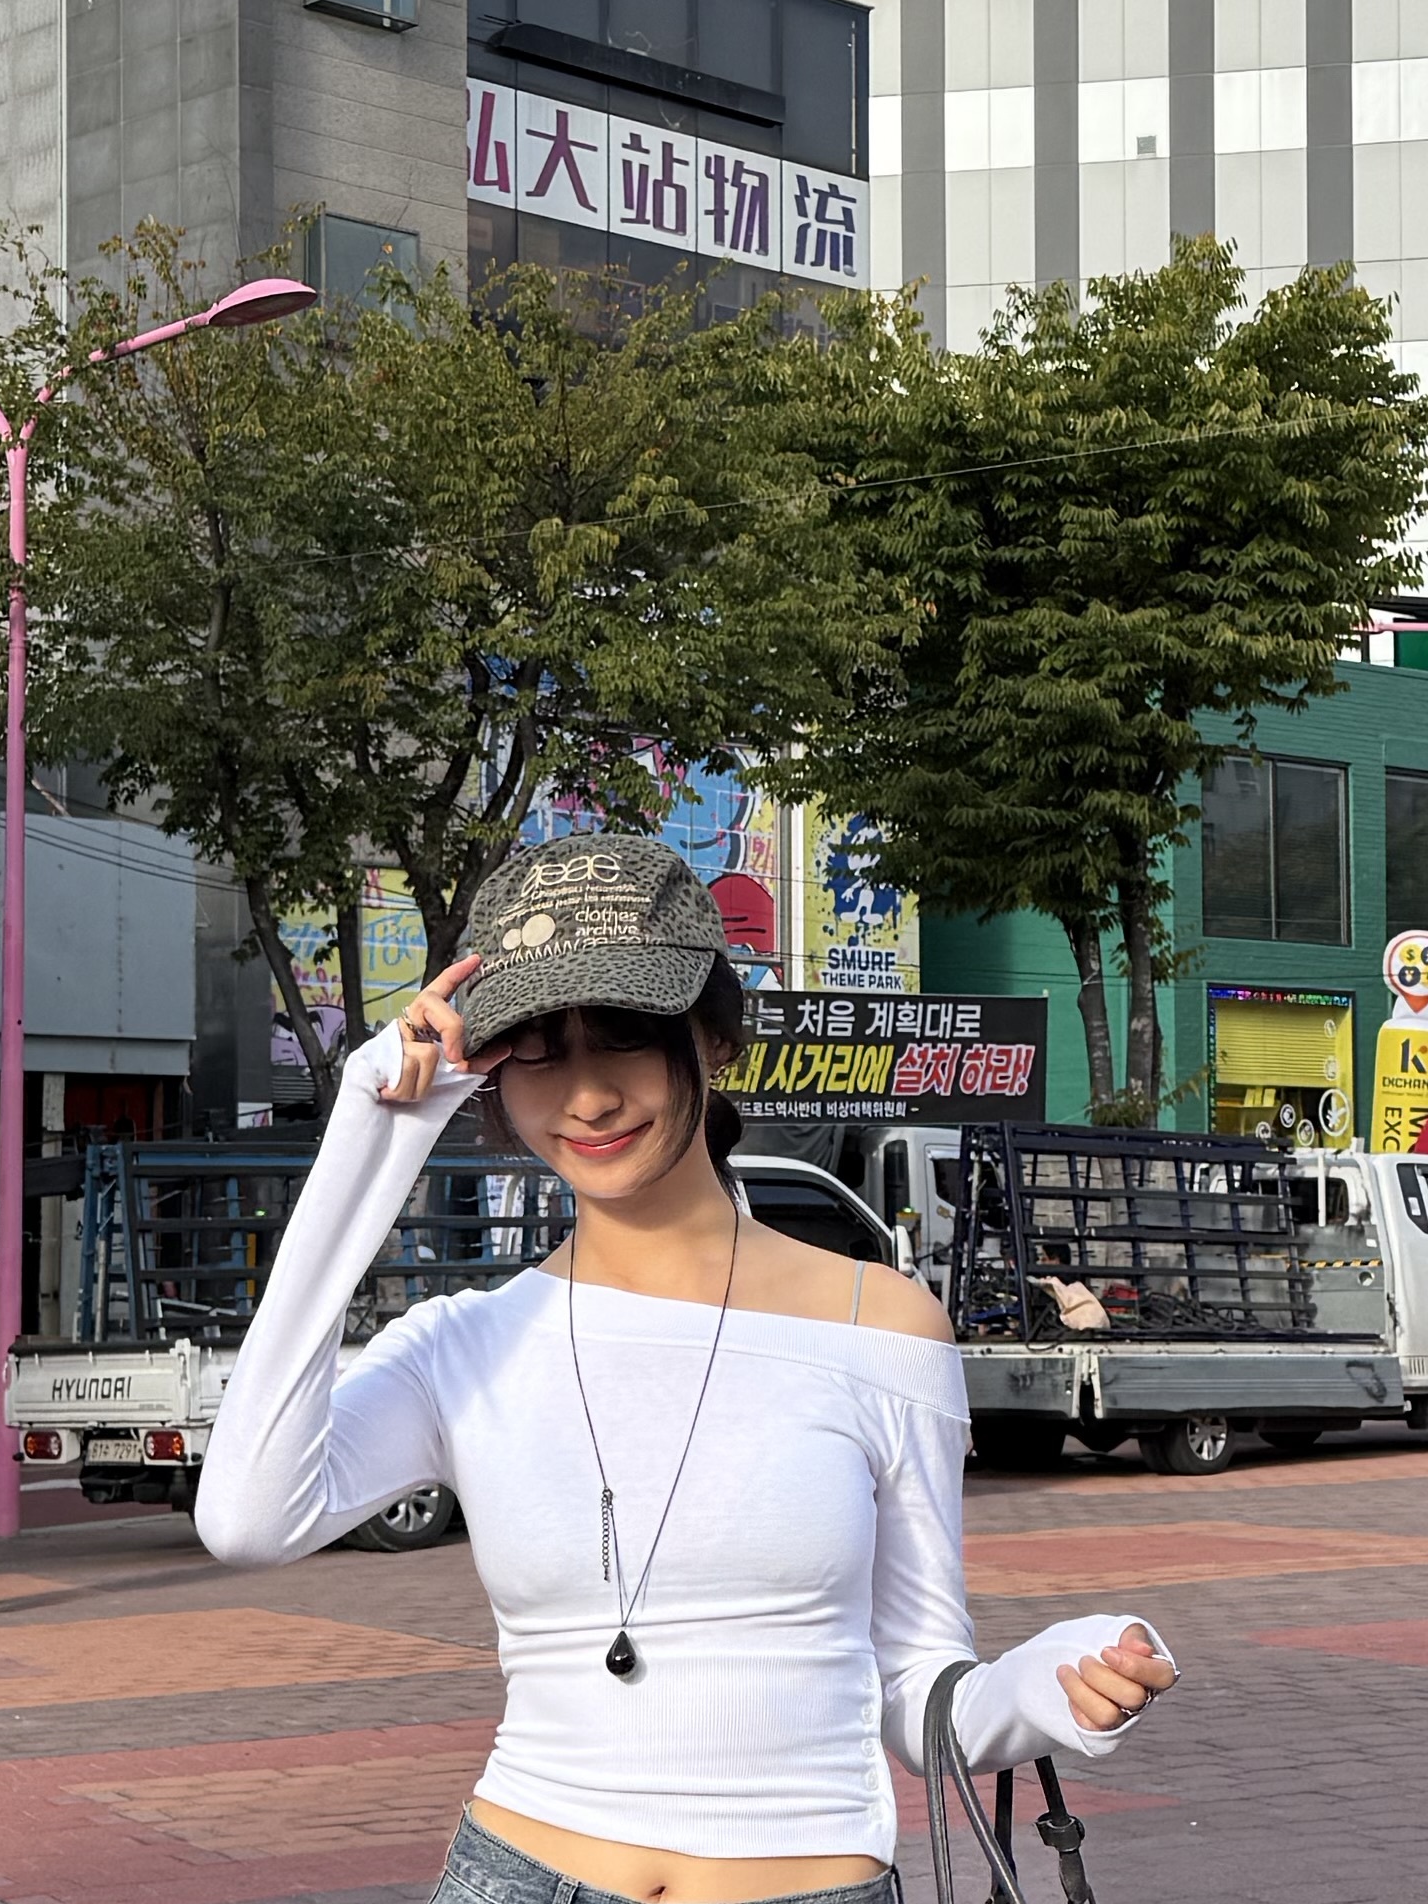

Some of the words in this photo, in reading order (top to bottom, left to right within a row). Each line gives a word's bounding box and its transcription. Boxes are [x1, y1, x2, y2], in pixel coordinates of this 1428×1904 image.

[828, 948, 896, 971] SMURF
[822, 972, 865, 987] THEME
[868, 974, 902, 989] PARK
[795, 999, 855, 1038] 처음
[865, 1001, 982, 1039] 계획대로
[765, 1043, 894, 1095] 사거리에
[891, 1043, 960, 1096] 설치
[960, 1044, 1035, 1096] 하라!
[826, 1101, 906, 1118] 비상대책위원회
[52, 1376, 132, 1400] HYUNDAI
